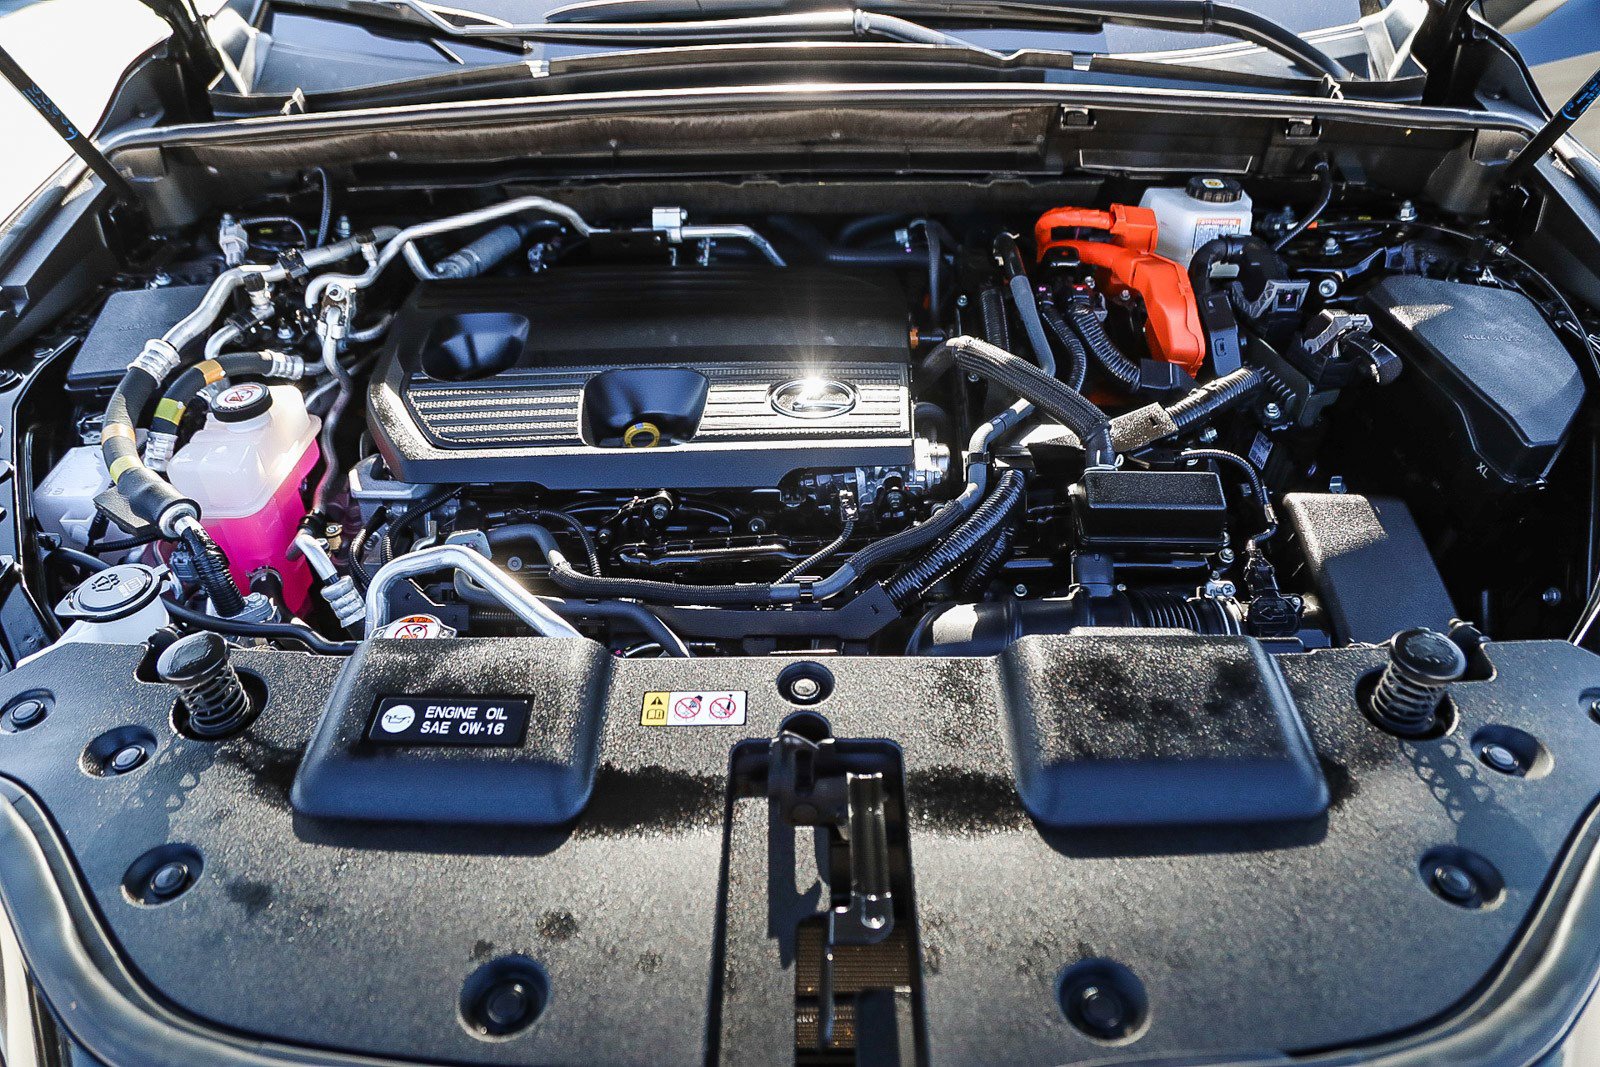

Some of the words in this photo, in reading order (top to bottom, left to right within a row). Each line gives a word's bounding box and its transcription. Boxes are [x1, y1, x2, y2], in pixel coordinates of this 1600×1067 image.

[424, 705, 478, 720] ENGINE
[485, 707, 508, 720] OIL
[420, 721, 451, 734] SAE
[458, 722, 505, 735] 0W-16
